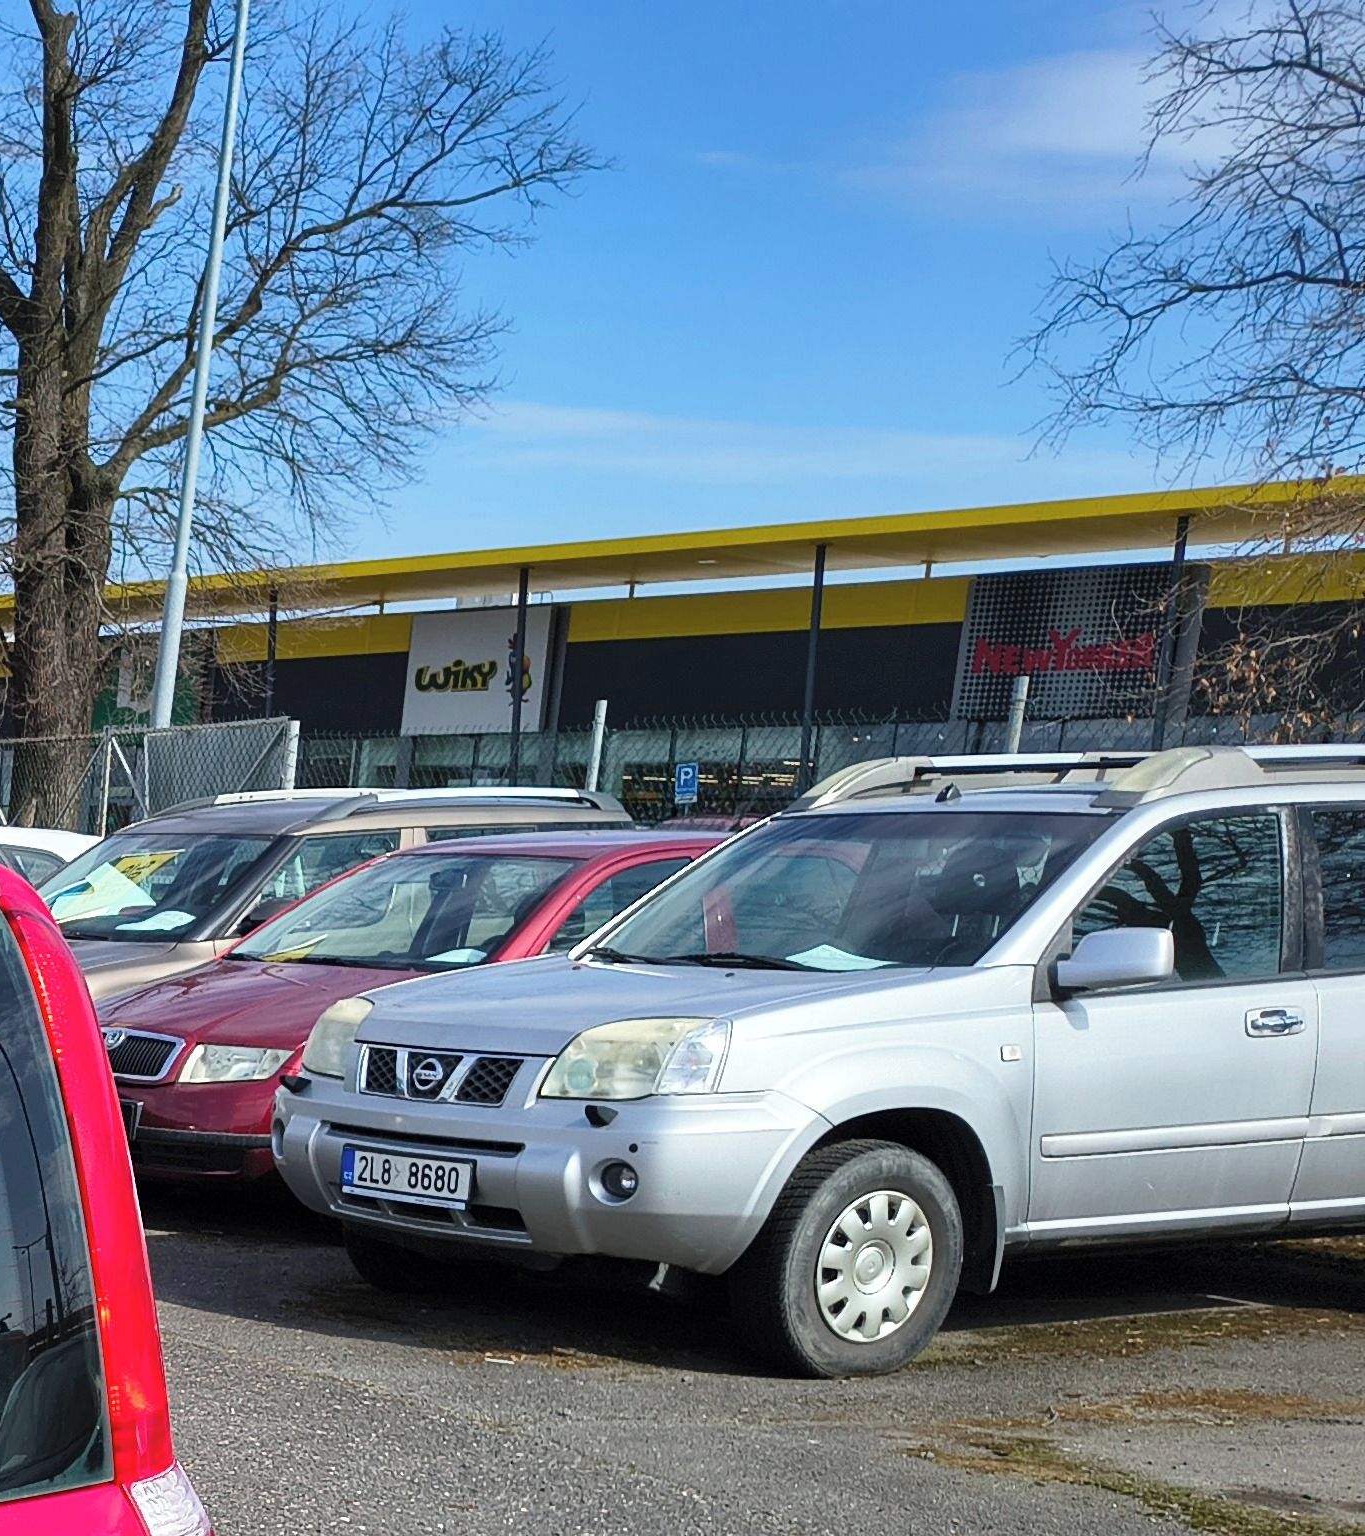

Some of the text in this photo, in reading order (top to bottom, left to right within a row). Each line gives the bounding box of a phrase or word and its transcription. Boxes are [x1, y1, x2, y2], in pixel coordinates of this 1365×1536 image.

[680, 767, 693, 786] P
[357, 1156, 460, 1194] 2L8 8680
